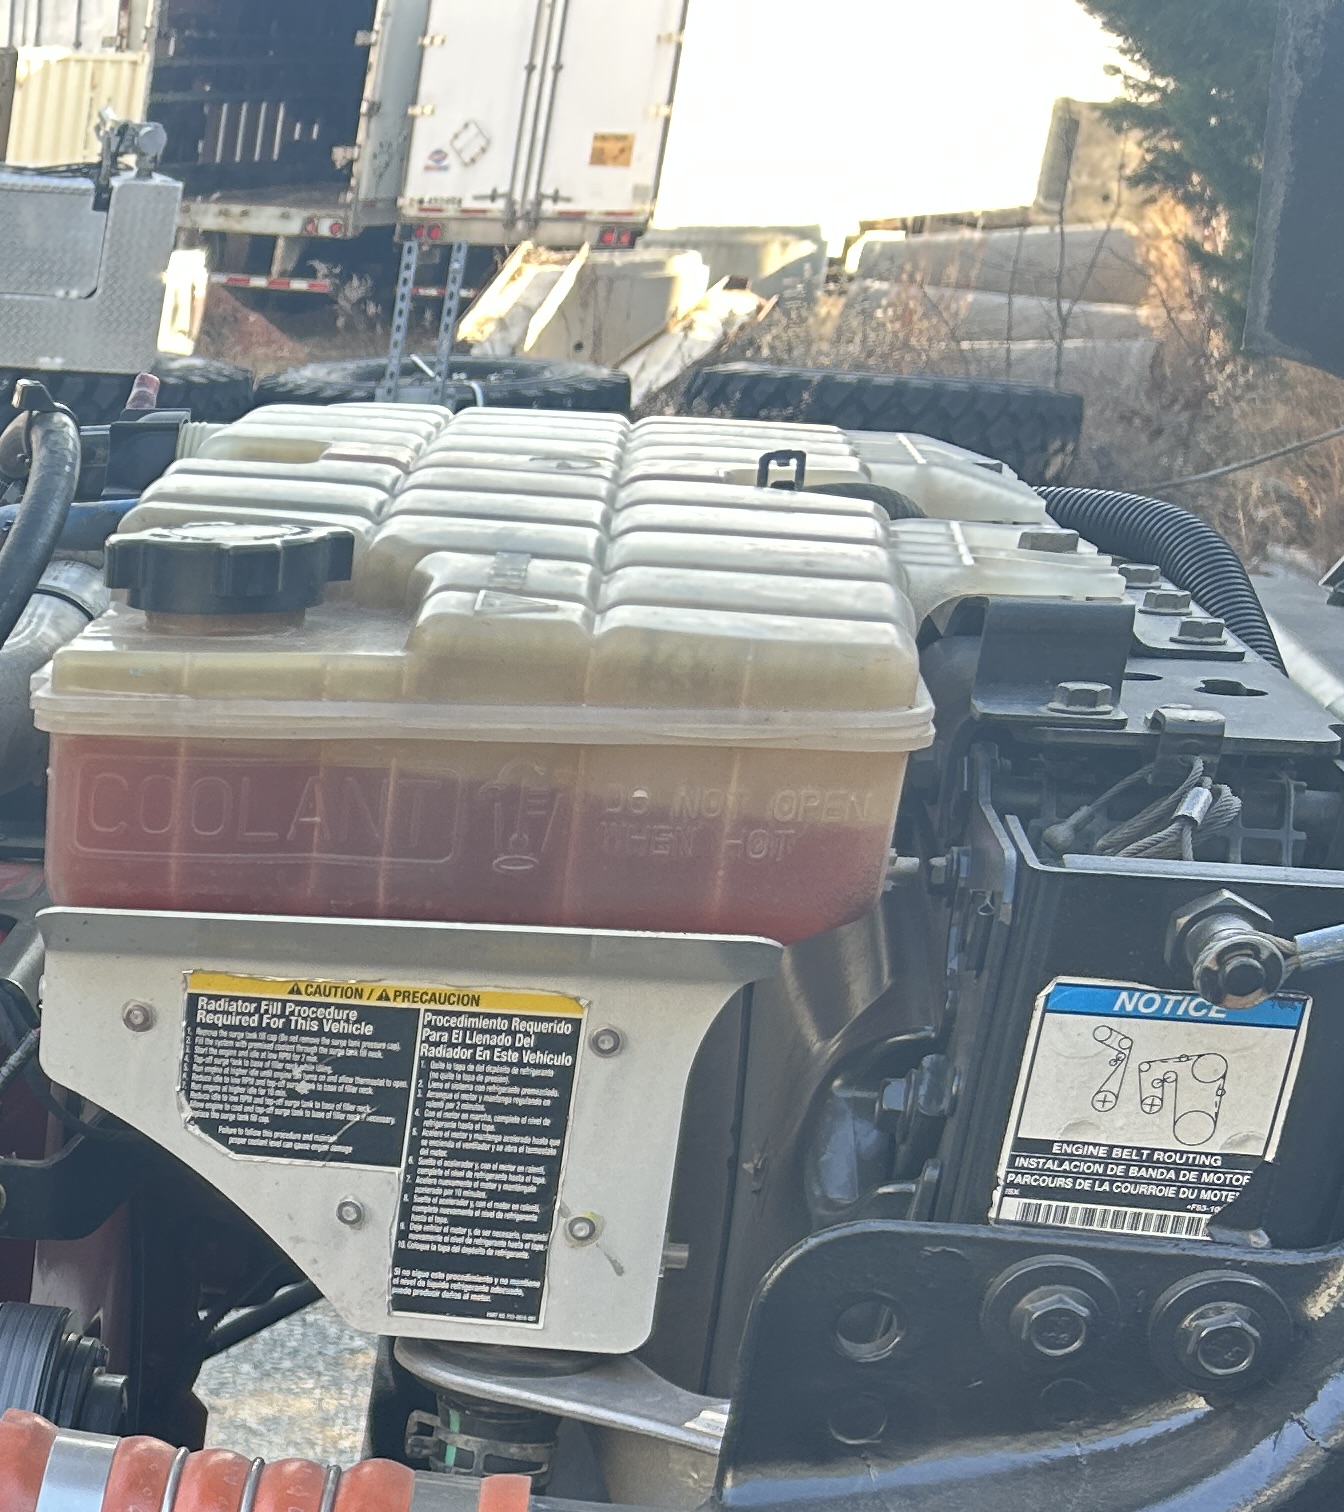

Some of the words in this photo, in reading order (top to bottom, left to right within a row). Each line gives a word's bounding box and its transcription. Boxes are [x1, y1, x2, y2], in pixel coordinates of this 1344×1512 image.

[89, 772, 443, 848] COOLANT
[603, 783, 650, 815] DO
[771, 789, 873, 823] OPEN
[602, 821, 698, 858] WHEN
[724, 828, 796, 862] HOT
[304, 983, 363, 1000] CAUTION
[393, 989, 480, 1007] PRECAUCION
[1112, 990, 1227, 1019] NOTICE
[198, 996, 257, 1014] Radiator
[261, 1001, 281, 1016] Fill
[285, 1002, 358, 1021] Procedure
[196, 1010, 259, 1027] Required
[262, 1014, 284, 1029] For
[289, 1016, 319, 1031] This
[323, 1019, 374, 1036] Vehicle
[424, 1012, 508, 1031] Procedimiento
[511, 1017, 572, 1035] Requerido
[422, 1028, 448, 1043] Para
[452, 1030, 462, 1044] El
[465, 1030, 512, 1047] Llenado
[515, 1034, 535, 1048] Del
[420, 1043, 473, 1060] Radiador
[476, 1047, 490, 1061] En
[493, 1048, 519, 1063] Este
[1052, 1142, 1108, 1158] ENGINE
[1111, 1147, 1148, 1161] BELT
[1153, 1151, 1222, 1167] ROUTING
[1015, 1156, 1105, 1175] INSTALACION
[1108, 1164, 1124, 1176] DE
[1128, 1166, 1176, 1181] BANDA
[1179, 1170, 1198, 1183] DE
[1007, 1173, 1072, 1189] PARCOURS
[1075, 1178, 1092, 1191] DE
[1094, 1180, 1110, 1192] LA
[1112, 1181, 1177, 1198] COURROIE
[1179, 1187, 1198, 1199] DU
